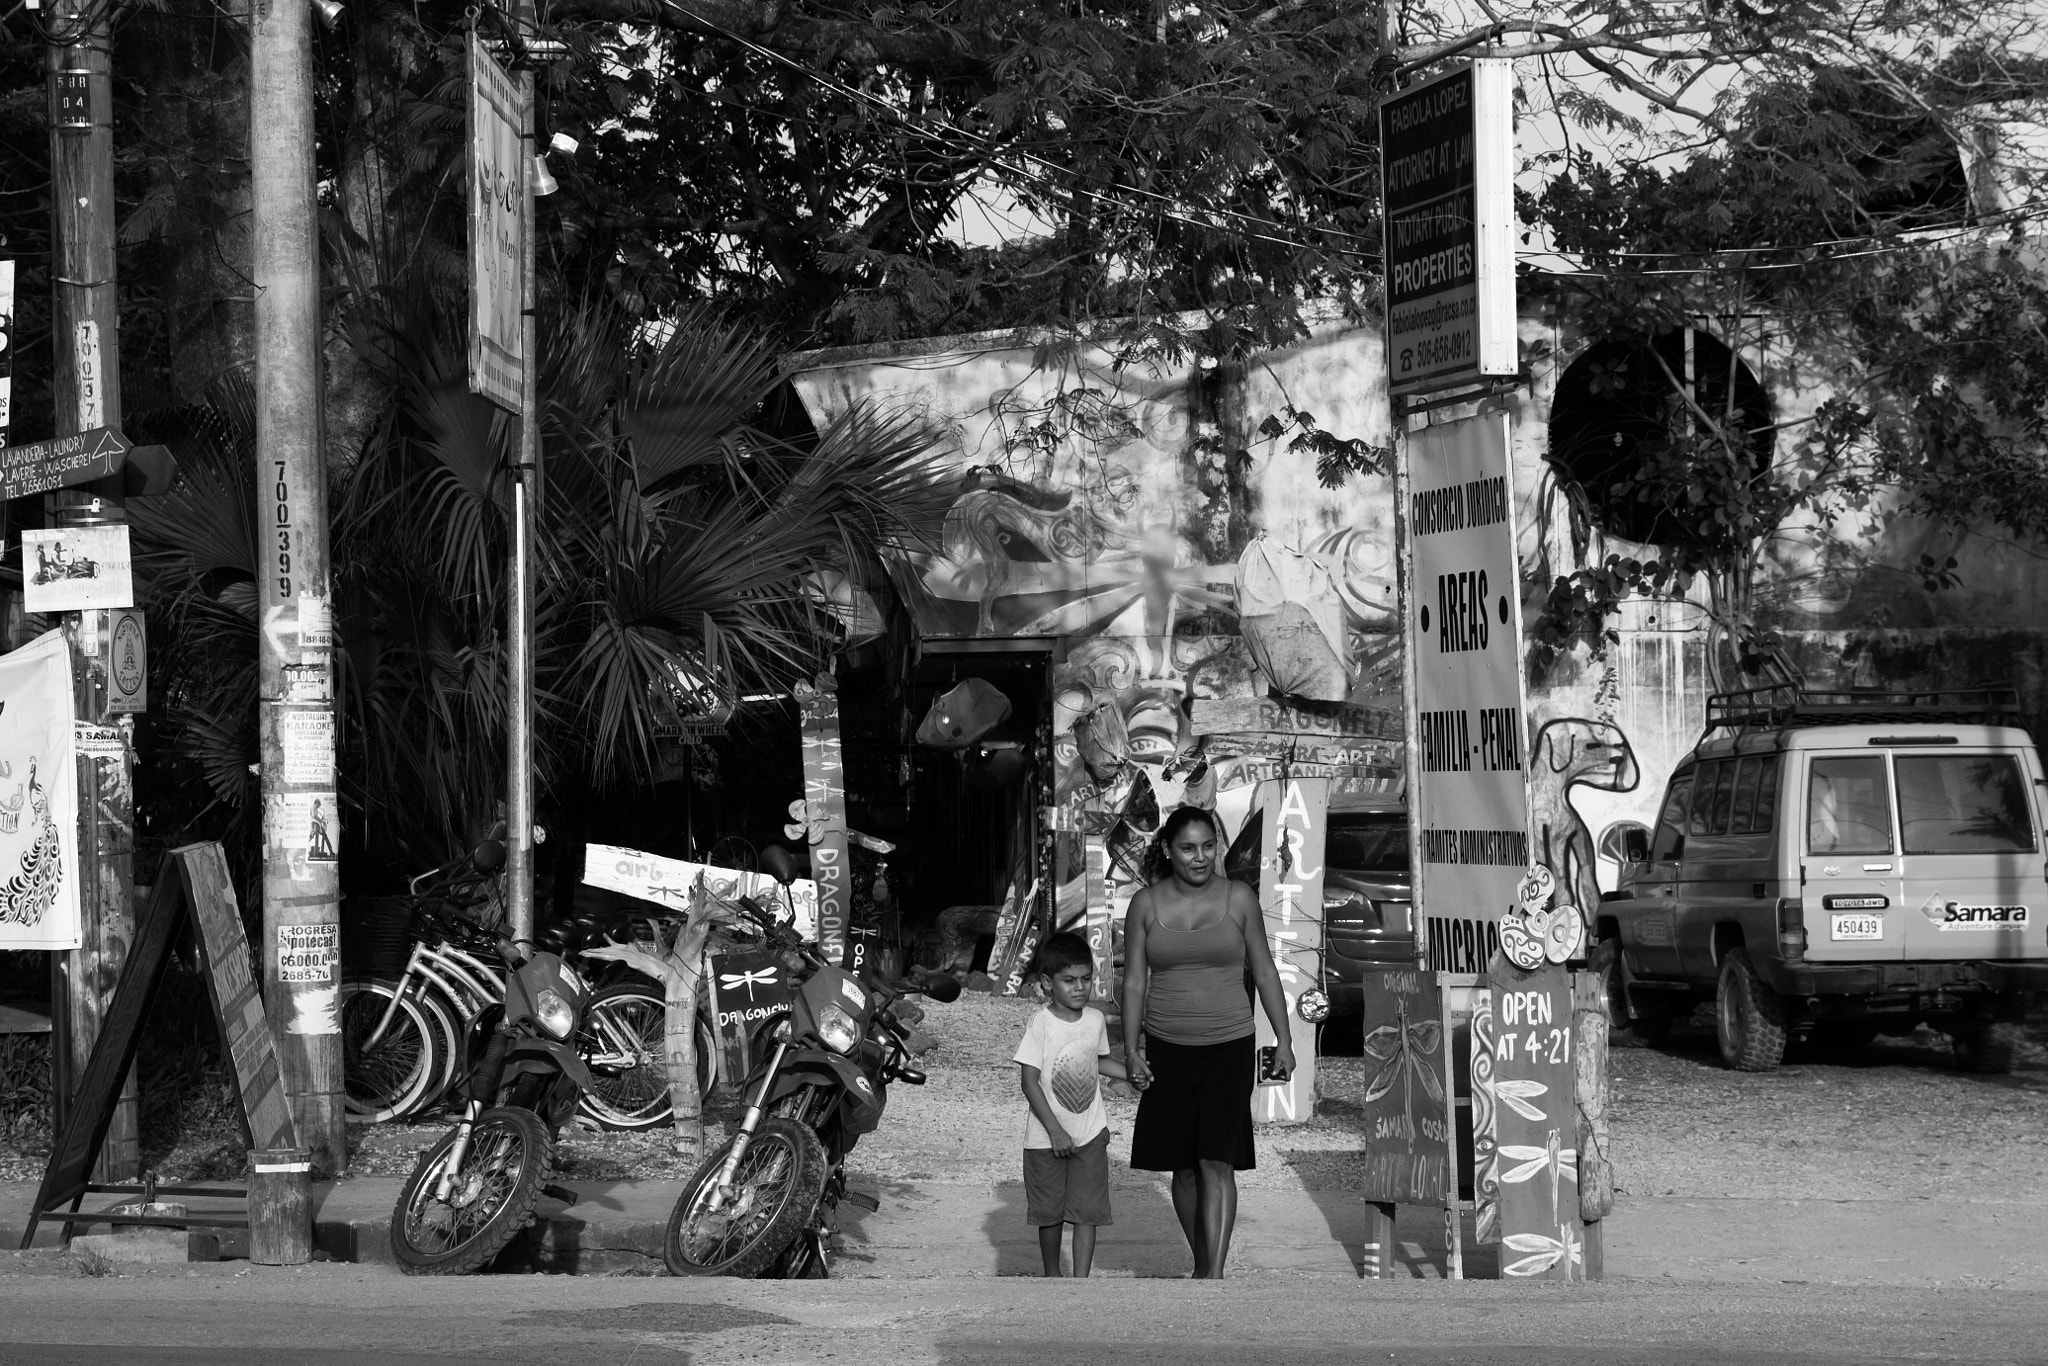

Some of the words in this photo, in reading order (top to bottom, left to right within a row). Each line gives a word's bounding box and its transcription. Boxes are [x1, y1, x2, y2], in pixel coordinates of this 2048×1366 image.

[1391, 96, 1432, 135] FABIOLA
[1434, 81, 1467, 117] LOPEZ
[1388, 146, 1436, 193] ATTORNEY
[1440, 140, 1450, 175] AT
[1454, 132, 1473, 169] LAW
[1397, 207, 1434, 249] NOTARY
[1436, 195, 1468, 237] PUBLIC
[1394, 242, 1472, 295] PROPERTIES
[1417, 329, 1471, 368] 506-656-0912
[5, 485, 20, 499] TEL
[22, 474, 64, 495] 26561051
[6, 464, 37, 484] LAVERIE
[1413, 484, 1464, 536] CONSORCIO
[1465, 470, 1506, 528] JURÍDICO
[1438, 569, 1489, 653] AREAS
[86, 731, 130, 740] SAMAA
[1420, 709, 1471, 772] FAMILIA
[1480, 708, 1521, 771] PENAL
[1460, 829, 1528, 867] ADMINISTRATIVOS
[1836, 920, 1877, 934] 450439
[1944, 902, 2026, 922] Samara
[1502, 991, 1552, 1025] OPEN
[1496, 1032, 1518, 1062] AT
[1524, 1026, 1570, 1065] 4:21
